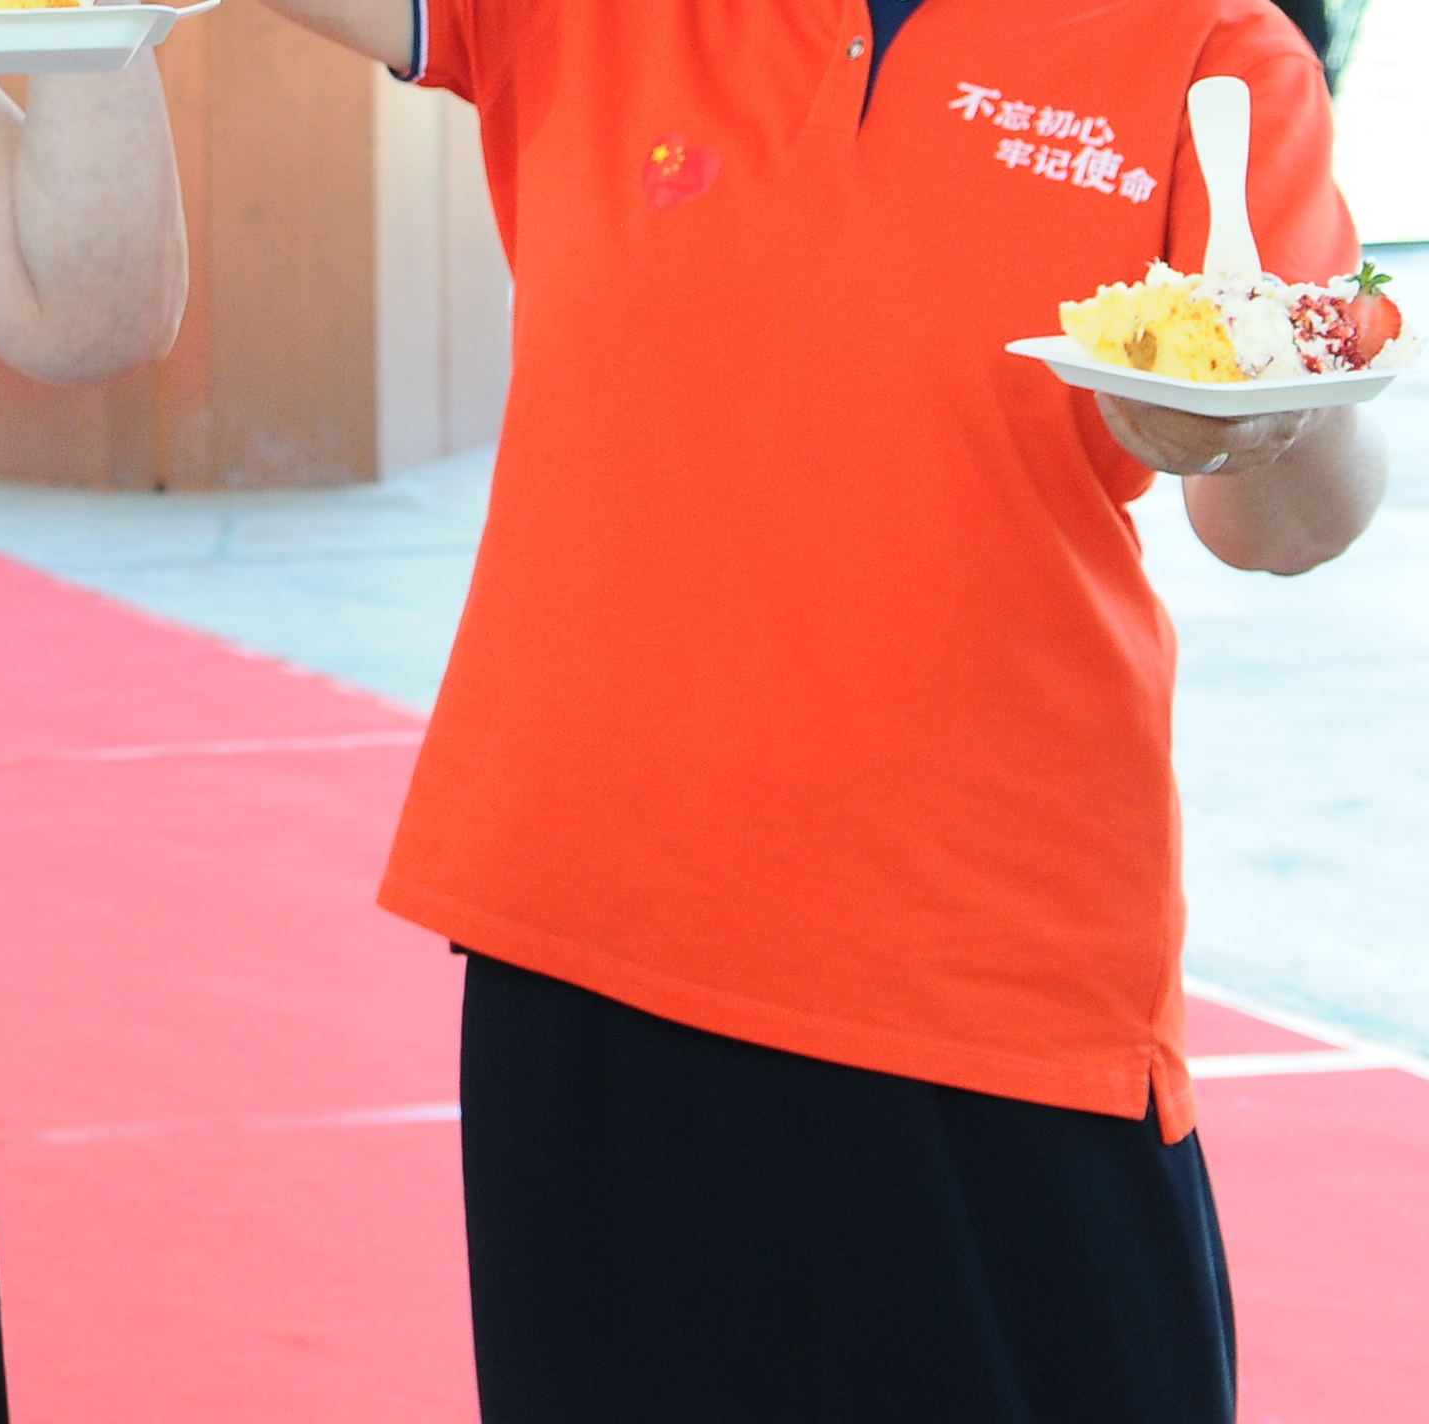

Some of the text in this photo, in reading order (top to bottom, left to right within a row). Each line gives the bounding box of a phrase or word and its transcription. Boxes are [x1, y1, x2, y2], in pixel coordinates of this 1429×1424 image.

[948, 82, 1116, 147] 不忘初心
[994, 138, 1158, 203] 牢记使命
